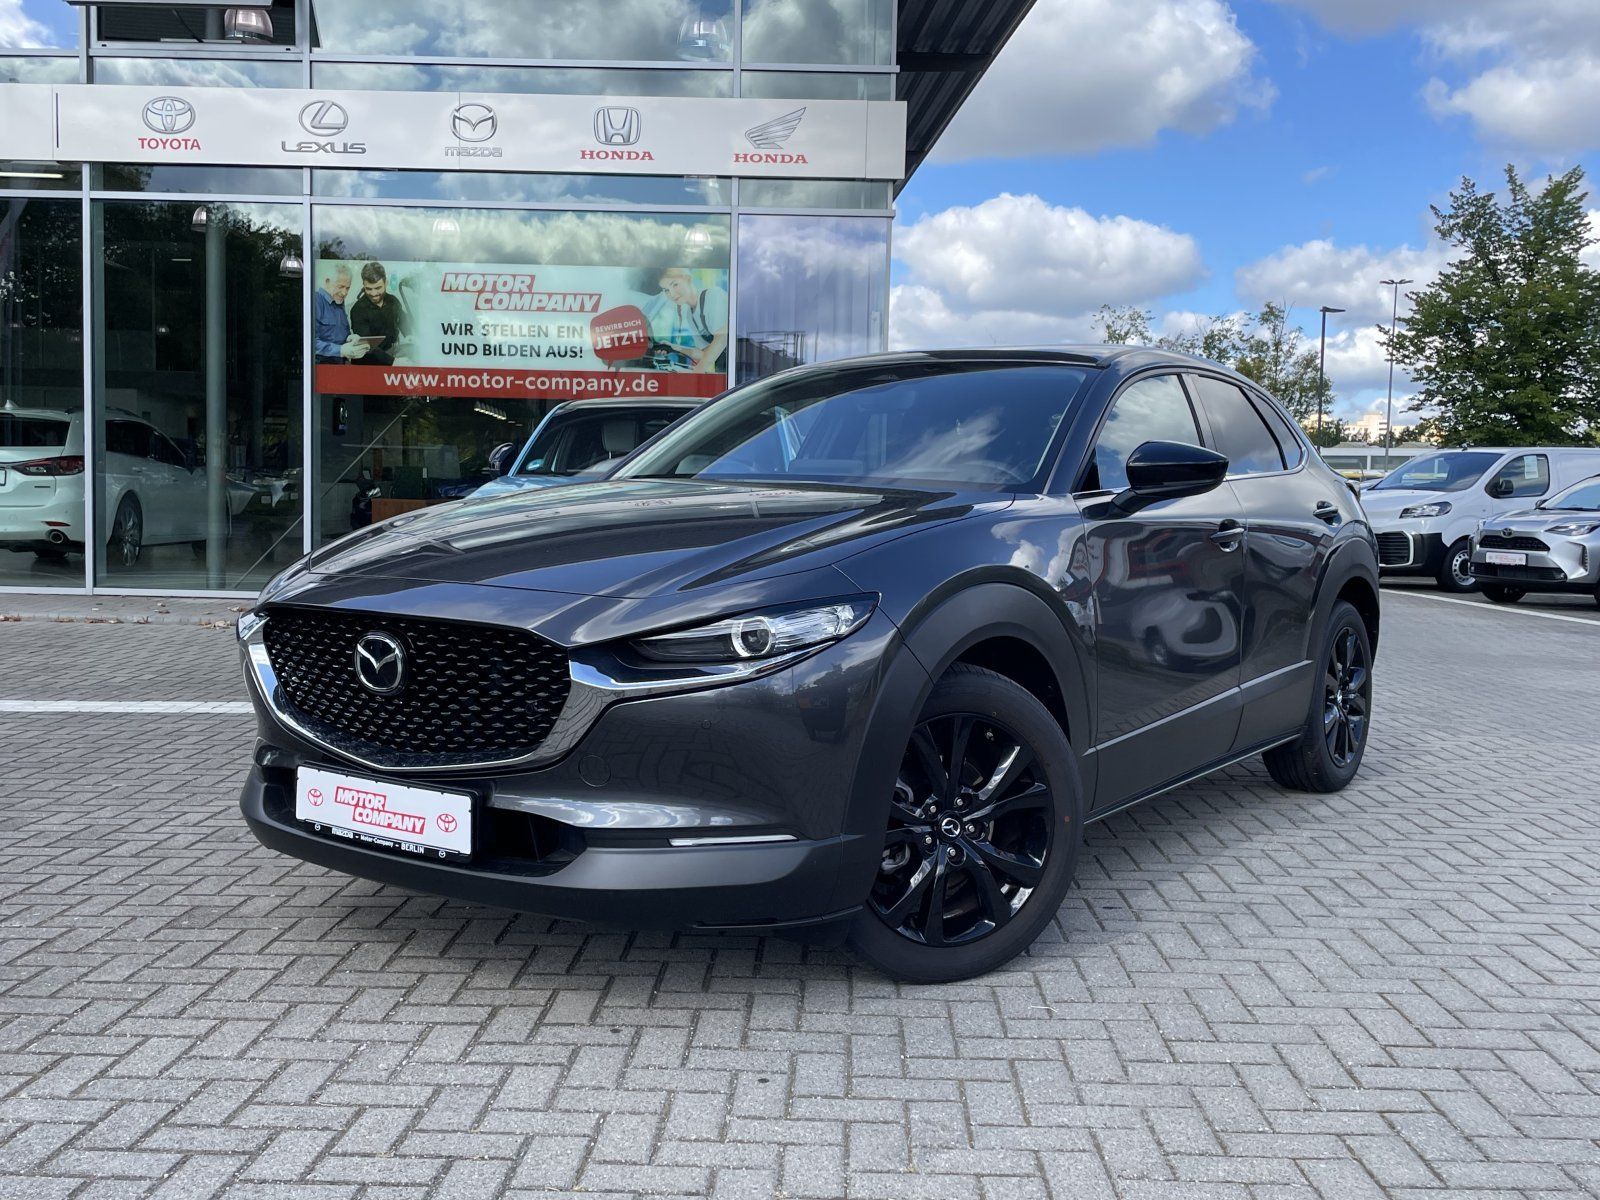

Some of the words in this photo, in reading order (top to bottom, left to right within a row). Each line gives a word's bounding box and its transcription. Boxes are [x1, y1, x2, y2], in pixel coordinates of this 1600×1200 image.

[138, 138, 201, 150] TOYOTA
[281, 141, 367, 154] LEXUS
[580, 150, 654, 161] HONDA
[733, 153, 808, 164] HONDA
[442, 273, 534, 292] MOTOR
[475, 292, 602, 312] COMPANY
[441, 323, 474, 336] WIR
[481, 324, 549, 338] STELLEN
[556, 326, 584, 339] EIN
[623, 319, 641, 328] DICH
[595, 329, 644, 350] JETZT!
[441, 343, 478, 356] UND
[482, 343, 542, 358] BILDEN
[545, 346, 583, 359] AUS!
[383, 372, 659, 396] www.motor-company.de
[335, 787, 386, 810] MOTOR
[353, 807, 425, 834] COMPANY
[401, 842, 425, 855] BERLIN
